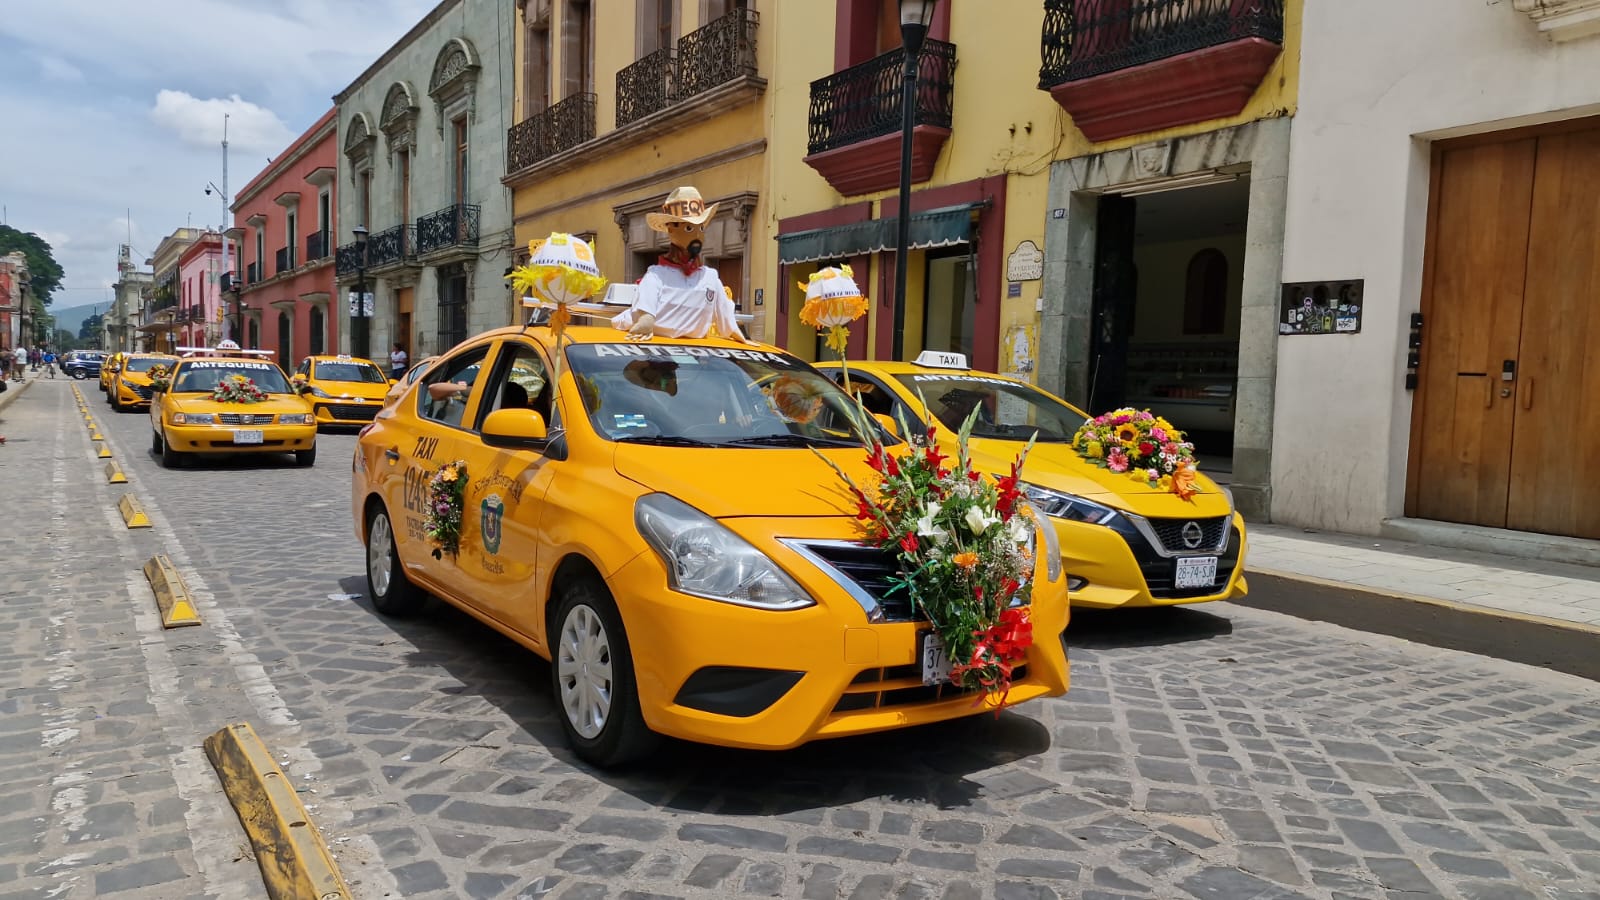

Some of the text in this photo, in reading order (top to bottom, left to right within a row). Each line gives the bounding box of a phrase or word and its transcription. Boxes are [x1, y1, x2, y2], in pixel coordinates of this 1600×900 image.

[594, 344, 791, 366] ANTEQUERA
[938, 355, 959, 366] TAXI
[190, 361, 270, 371] ANTEQUERA
[913, 374, 1024, 389] ANTEQUERA
[412, 436, 439, 460] TAXI
